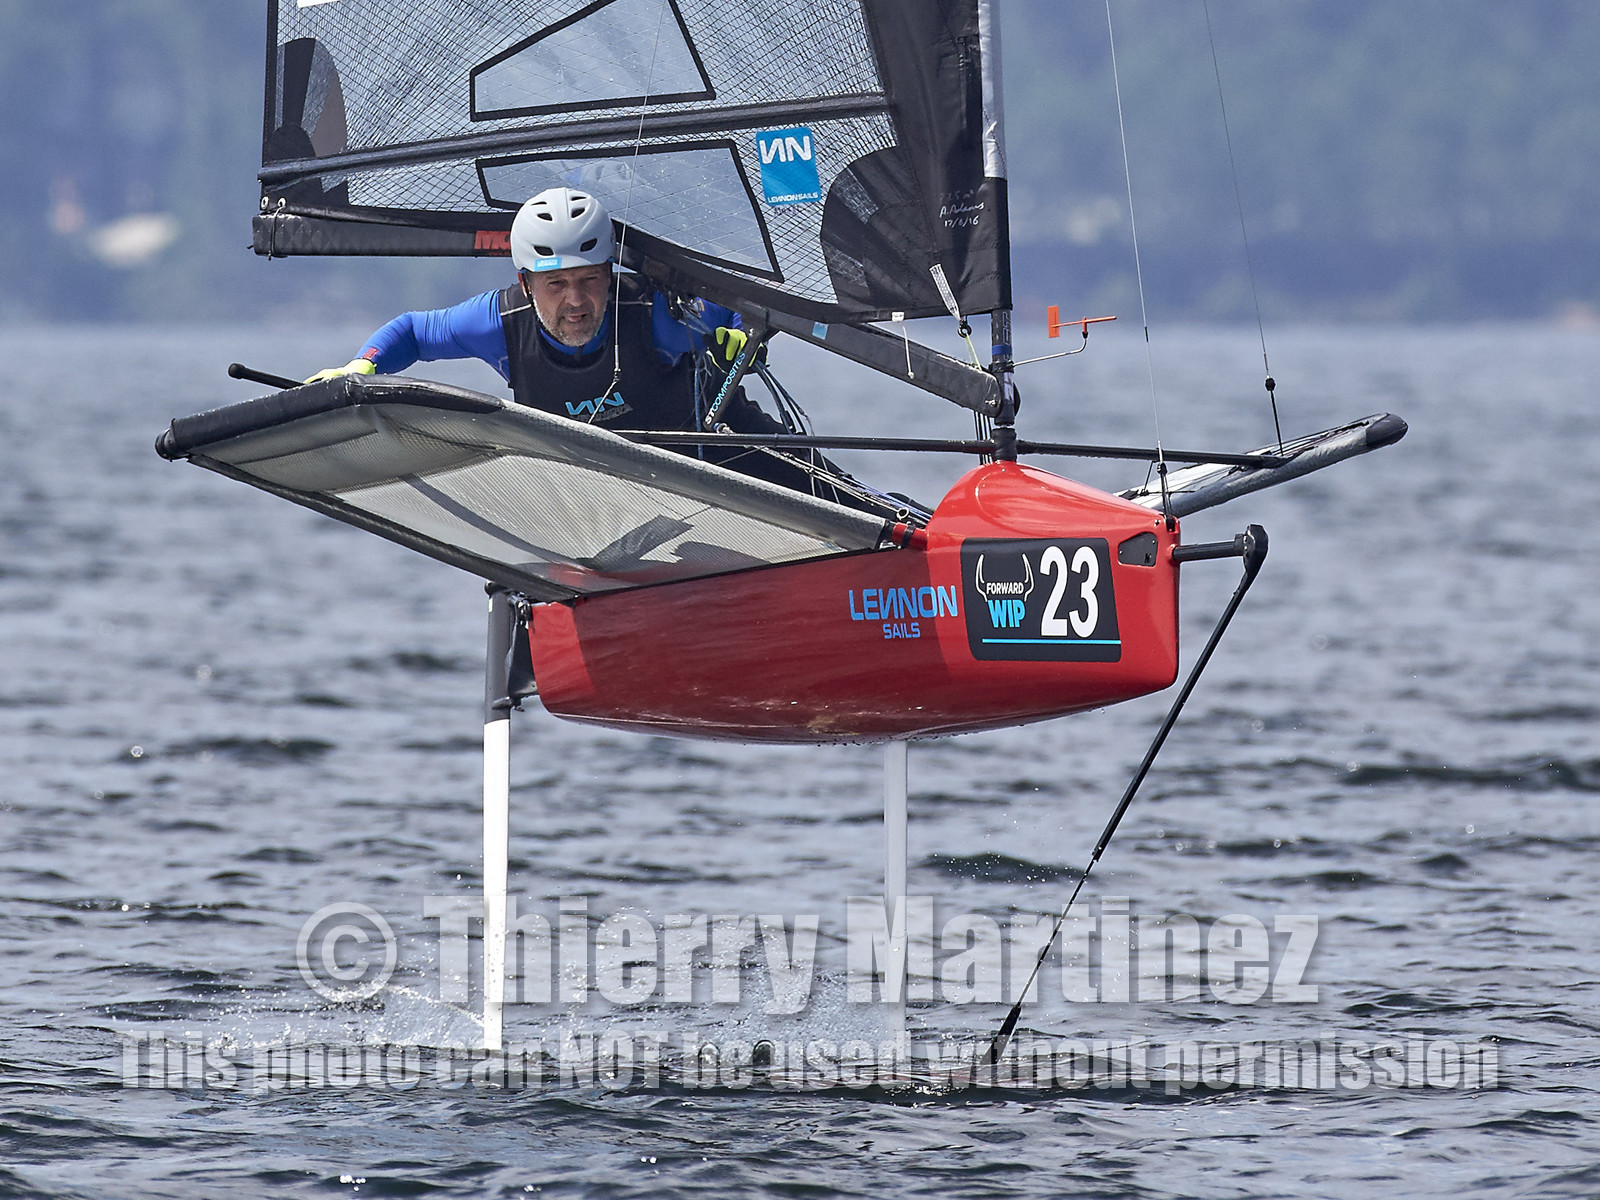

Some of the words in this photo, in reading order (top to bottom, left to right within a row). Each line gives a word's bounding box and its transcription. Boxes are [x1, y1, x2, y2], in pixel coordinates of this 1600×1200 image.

[848, 585, 959, 622] LENNON
[985, 581, 1026, 596] FORWARD
[1038, 545, 1101, 639] 23
[987, 599, 1027, 629] WIP
[882, 622, 922, 640] SAILS
